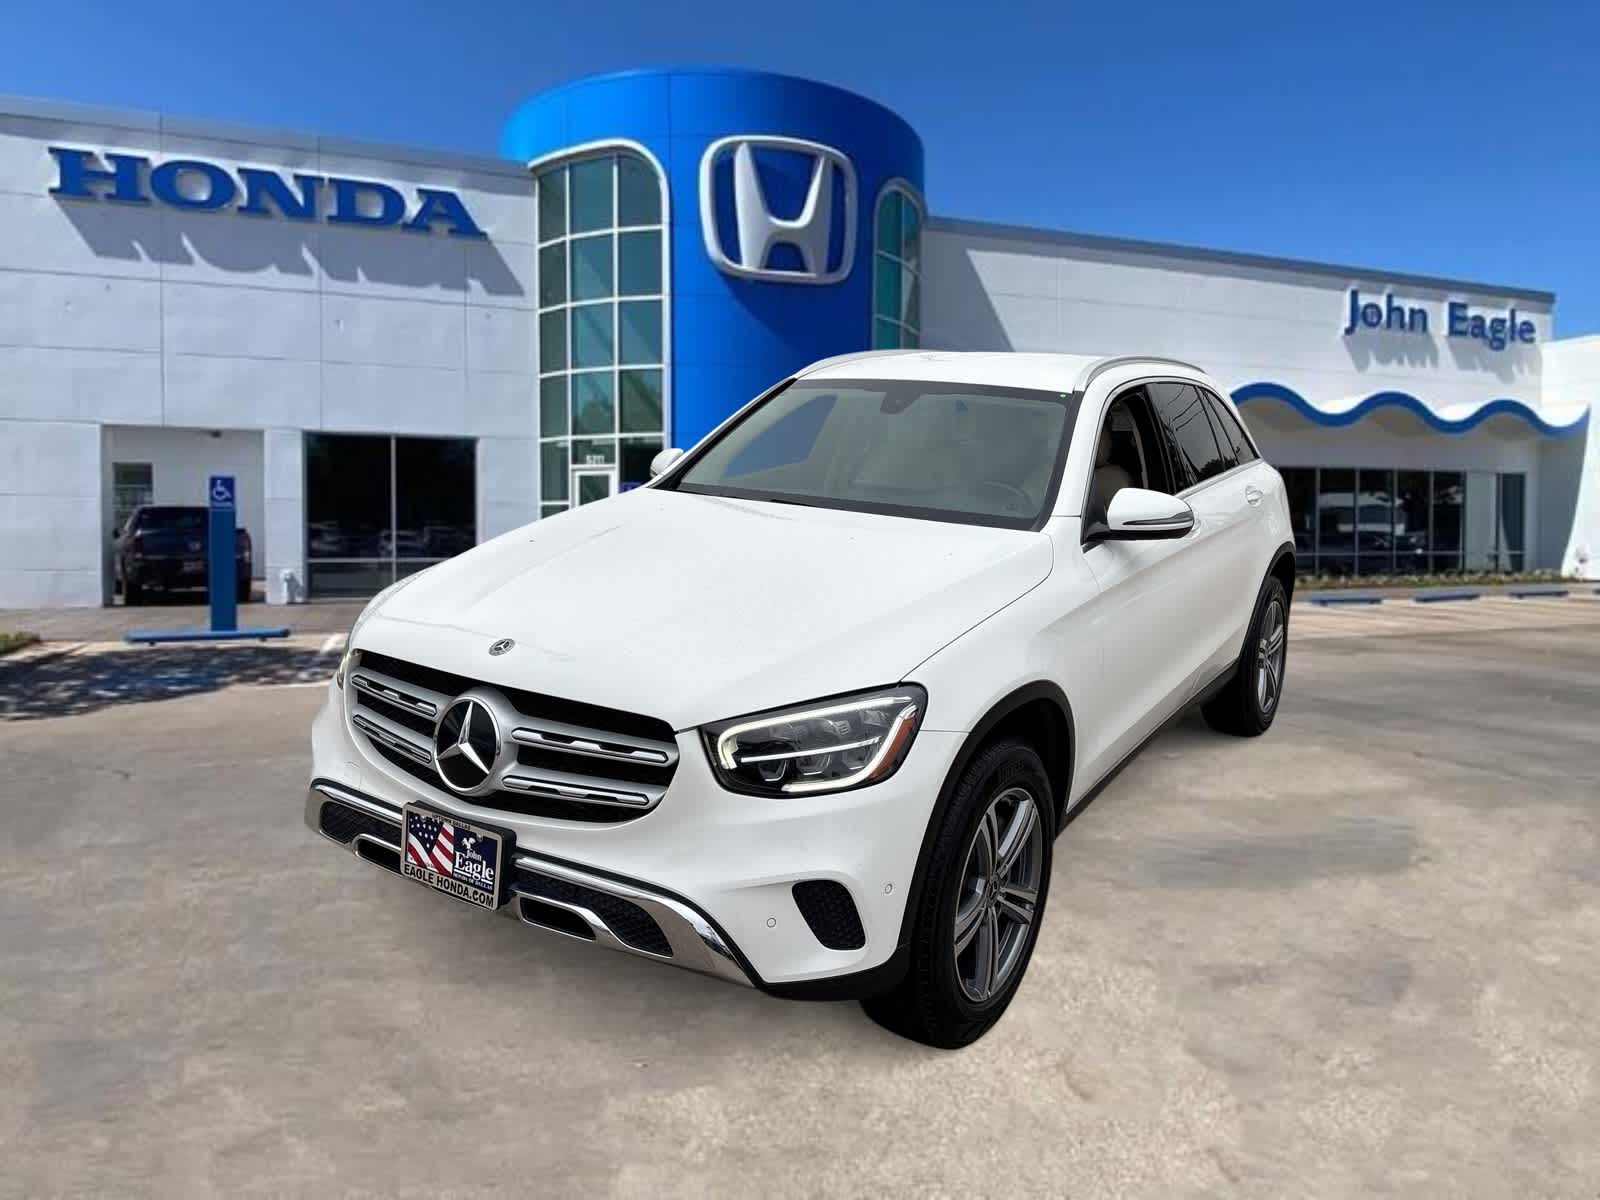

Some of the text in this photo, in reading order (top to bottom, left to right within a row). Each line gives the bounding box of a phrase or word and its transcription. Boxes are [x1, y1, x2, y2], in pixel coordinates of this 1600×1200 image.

[48, 146, 489, 241] HONDA
[1344, 289, 1537, 351] John Eagle
[454, 850, 495, 881] Eagle
[465, 848, 482, 862] John
[404, 863, 494, 907] EAGLE HONDA.COM
